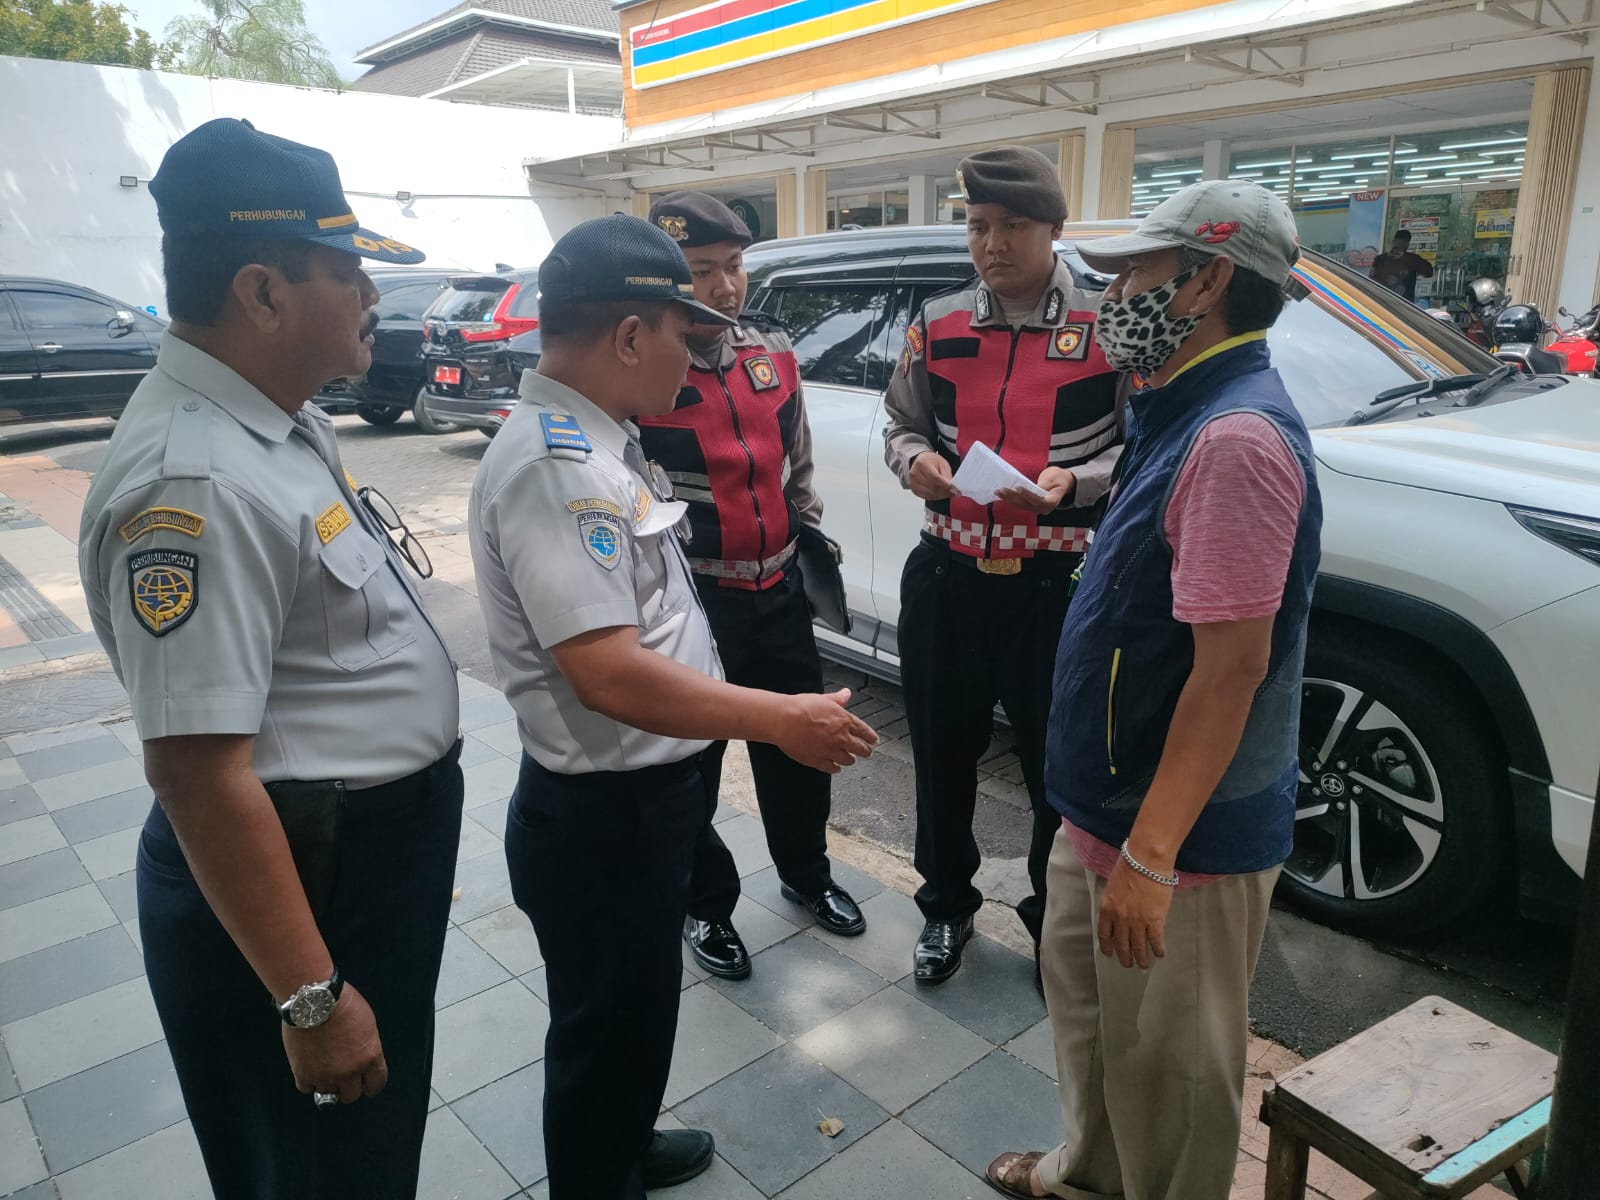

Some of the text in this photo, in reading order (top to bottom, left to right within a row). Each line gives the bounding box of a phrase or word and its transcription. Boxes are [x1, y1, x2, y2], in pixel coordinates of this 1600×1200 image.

[1357, 192, 1380, 201] NEW
[229, 209, 306, 222] PERHUBUNGAN
[625, 276, 673, 286] PERHUBUNGAN
[142, 511, 200, 532] PERHUBUNGAN
[580, 513, 619, 526] PERHUBUNGAN
[131, 552, 195, 569] PERHUBUNGAN
